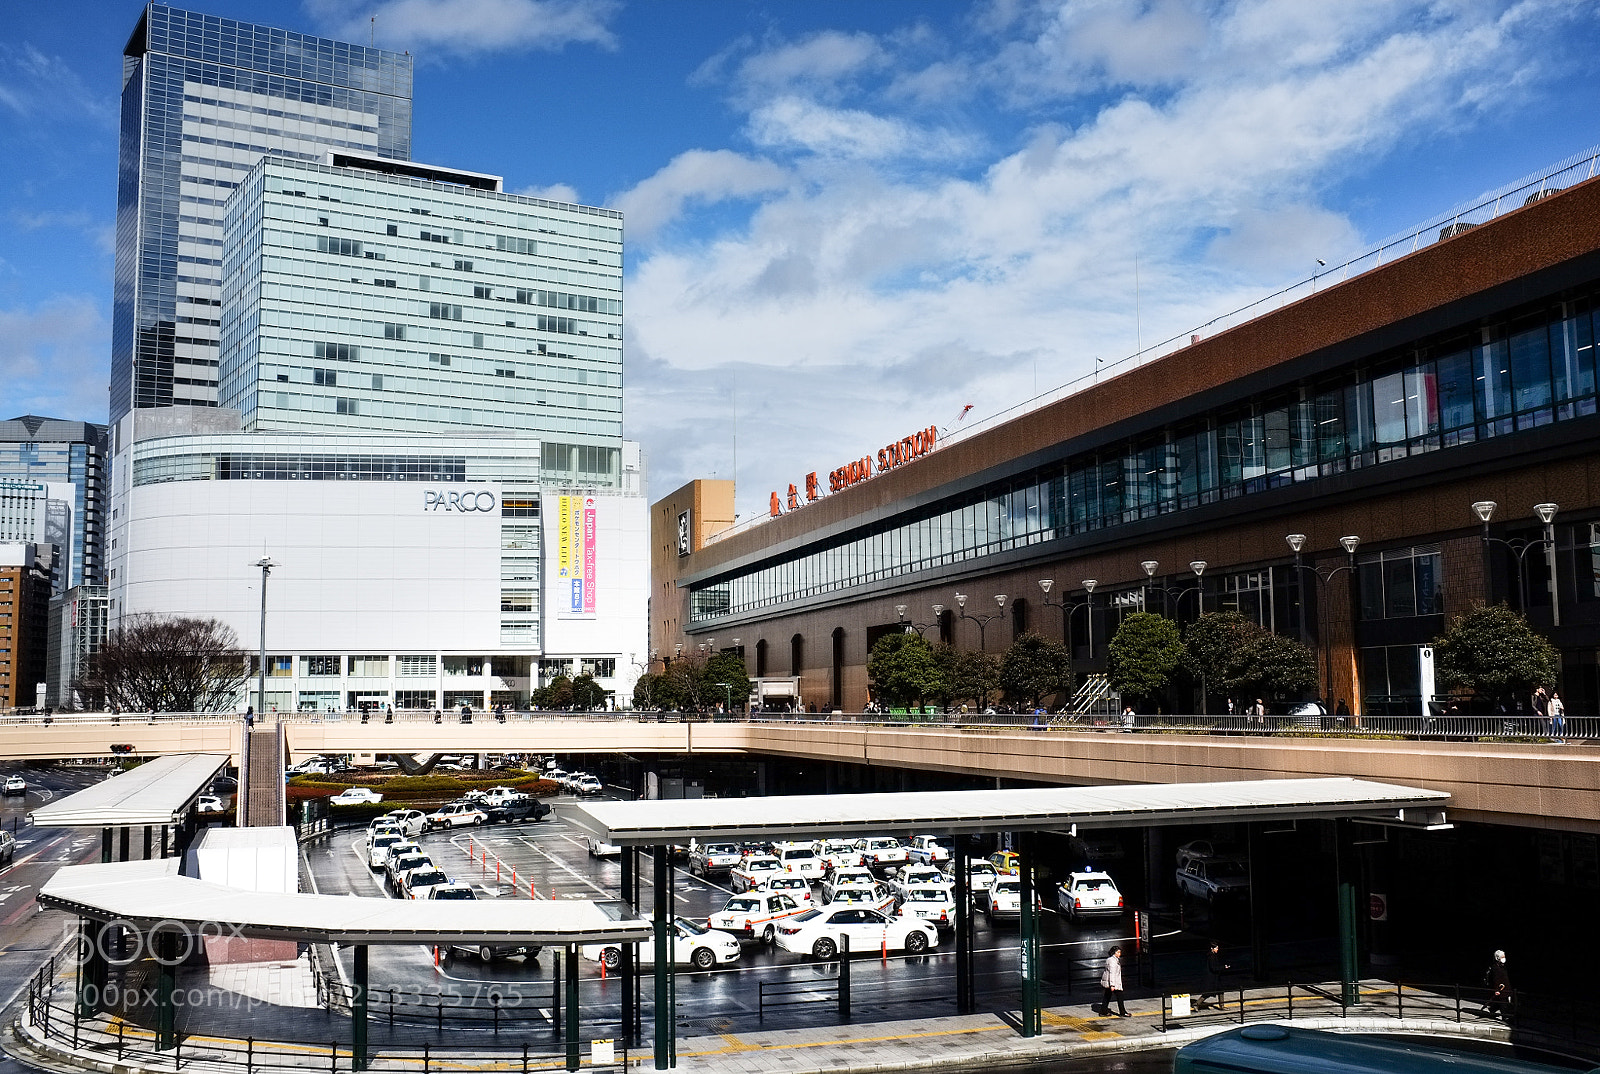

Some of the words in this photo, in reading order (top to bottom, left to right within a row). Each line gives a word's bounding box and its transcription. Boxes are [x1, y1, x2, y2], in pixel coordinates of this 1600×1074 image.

[829, 455, 871, 492] SENDAI
[878, 425, 936, 472] STATION
[424, 490, 495, 512] PARCO
[586, 545, 595, 579] Tax-free
[585, 581, 595, 604] Shop
